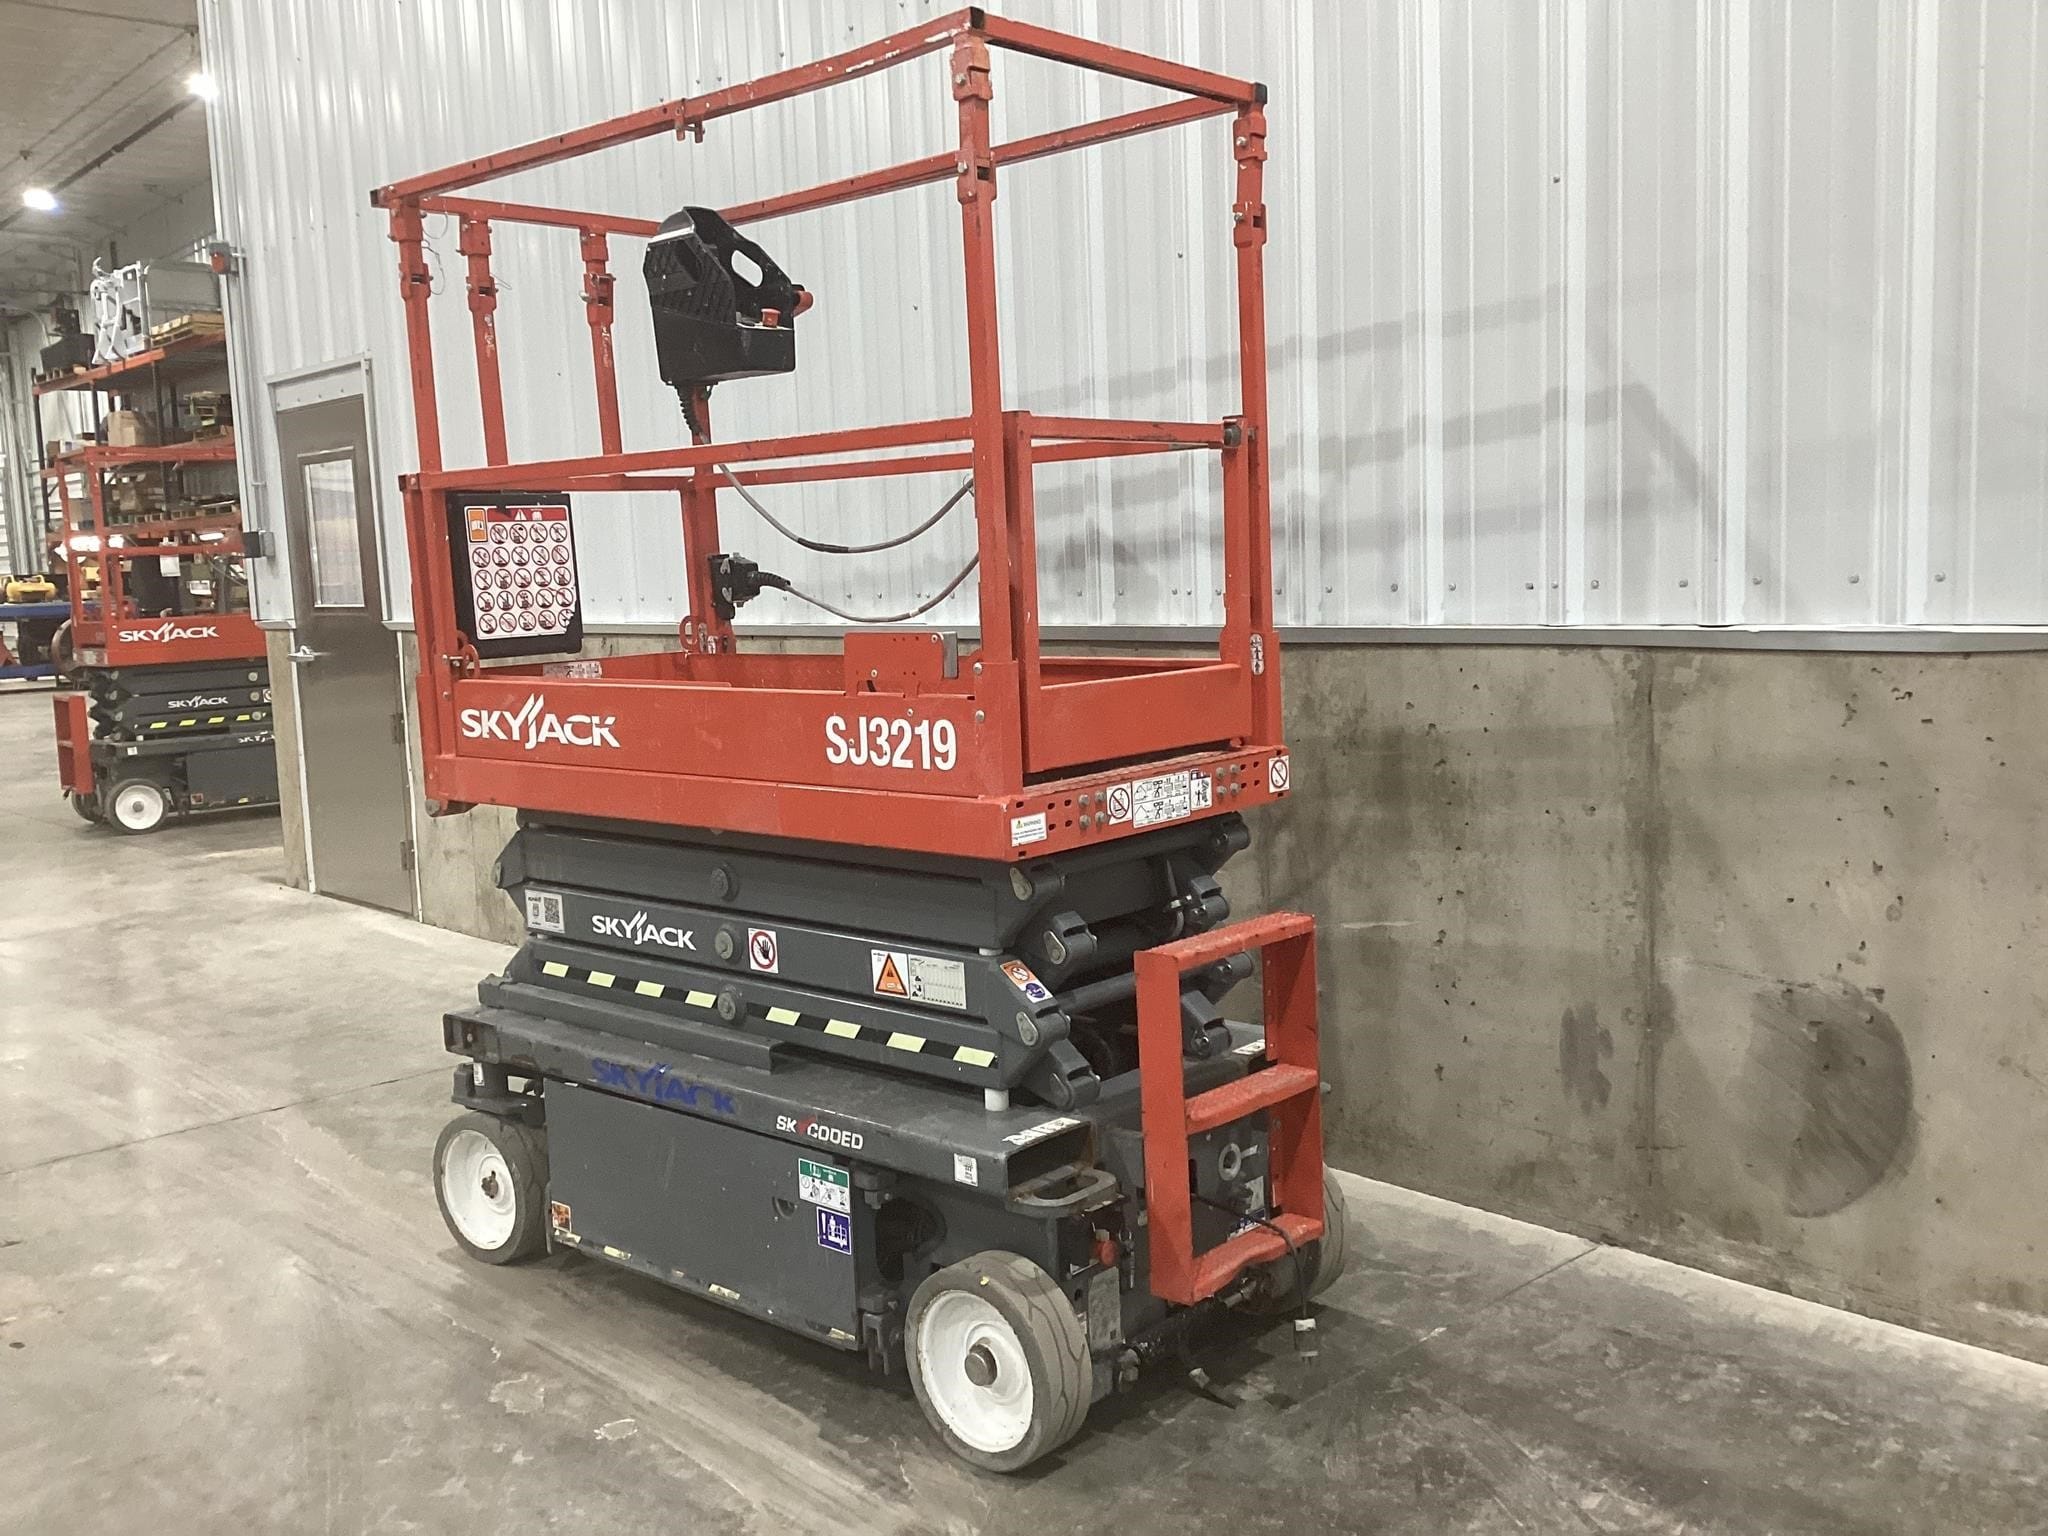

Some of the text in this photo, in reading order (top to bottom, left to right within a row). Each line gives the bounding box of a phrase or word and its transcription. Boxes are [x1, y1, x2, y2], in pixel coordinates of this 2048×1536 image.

[119, 622, 220, 643] SKYJACK
[168, 695, 229, 709] SKYJACK
[460, 693, 621, 750] SKYJACK
[825, 714, 957, 771] SJ3219
[591, 910, 696, 951] SKYJACK
